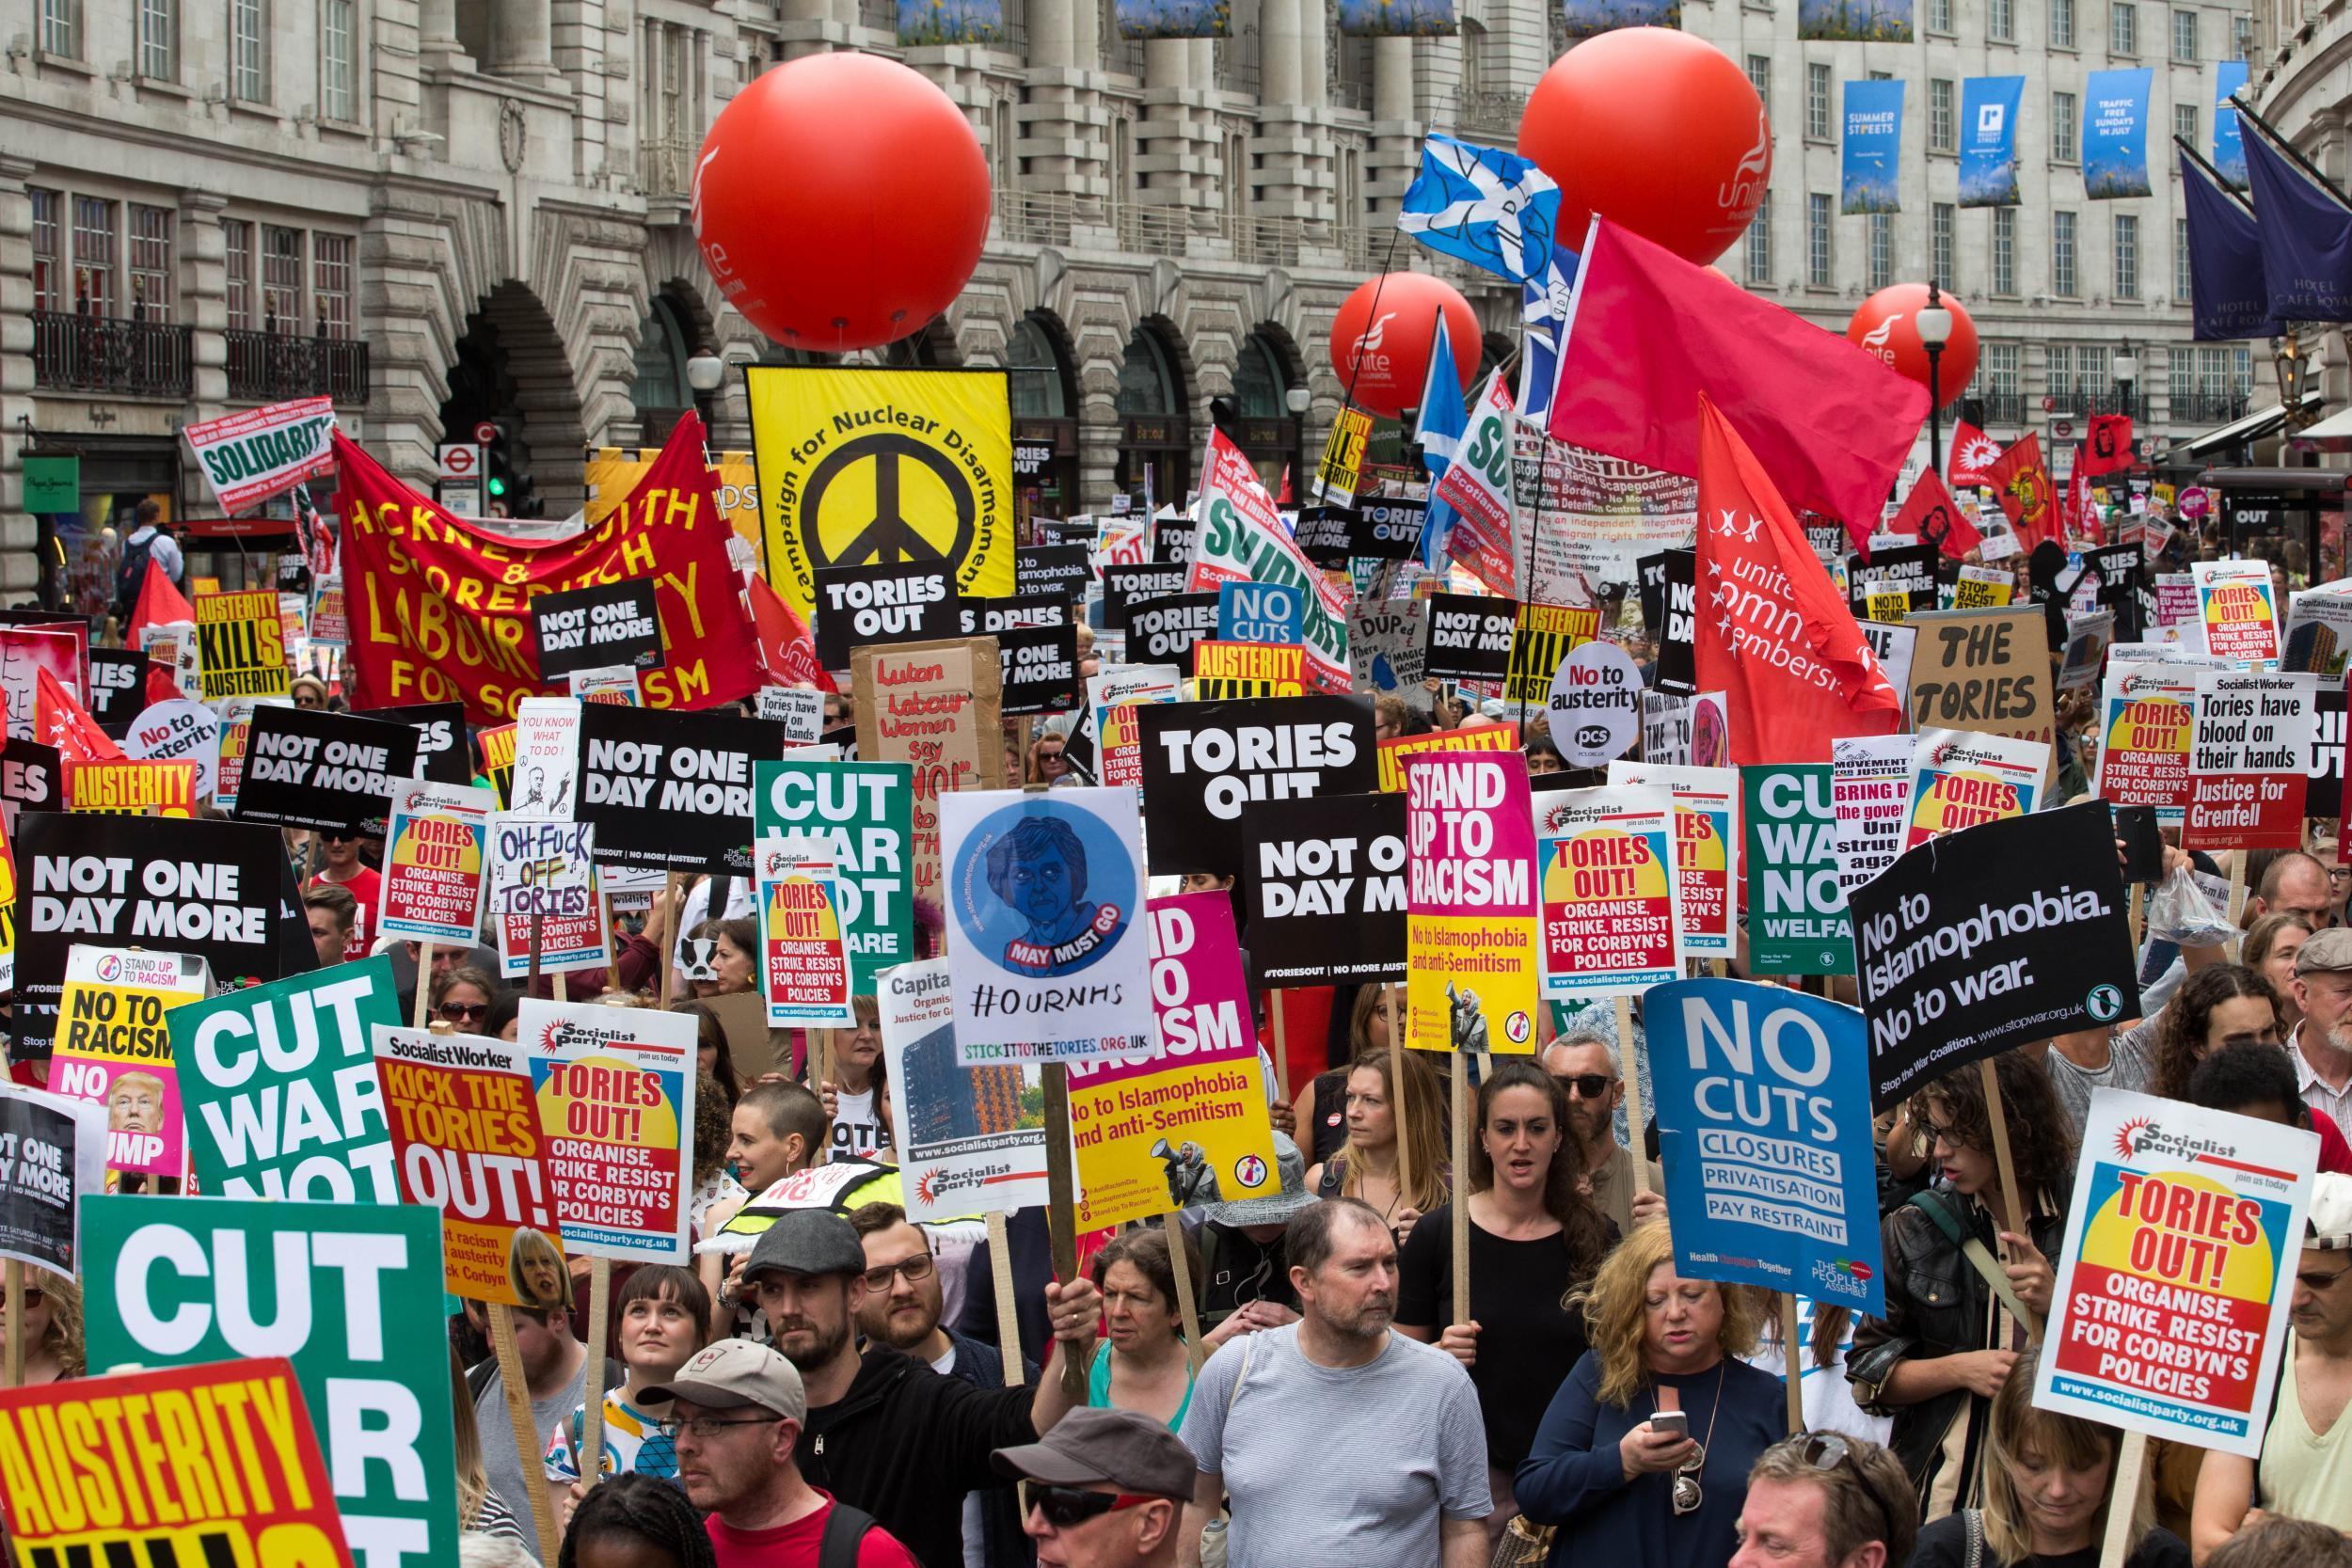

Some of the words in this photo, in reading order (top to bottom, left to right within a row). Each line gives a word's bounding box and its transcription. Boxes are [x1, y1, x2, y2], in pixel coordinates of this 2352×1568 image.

[1849, 112, 1894, 123] SUMMER
[2099, 99, 2134, 109] TRAFFIC
[2105, 109, 2126, 118] FREE
[1848, 124, 1894, 135] STREETS
[2095, 117, 2134, 128] SUNDAYS
[2100, 127, 2109, 135] IN
[2111, 126, 2131, 135] JULY
[2295, 279, 2337, 293] HOTEL
[1346, 353, 1390, 372] unite
[832, 405, 941, 436] Nuclear
[203, 417, 330, 484] SOLIDARITY
[789, 428, 828, 462] for
[1514, 462, 1538, 477] Stop
[1543, 465, 1561, 479] the
[1565, 467, 1597, 487] Racist
[1599, 476, 1678, 494] Scapegoating
[1563, 484, 1601, 499] Borders
[944, 428, 996, 594] Disarmament
[1561, 497, 1604, 514] Detention
[1606, 505, 1641, 514] Centres
[1609, 494, 1623, 504] No
[1626, 491, 1652, 503] More
[1648, 499, 1670, 514] Stop
[1672, 499, 1696, 511] Raids
[778, 468, 816, 603] Campaign
[1602, 531, 1632, 543] rights
[1637, 531, 1687, 541] movement
[826, 575, 946, 610] TORIES
[1958, 592, 1996, 606] RACIST
[1959, 579, 1989, 592] STOP
[2210, 587, 2260, 604] TORIES
[196, 591, 278, 623] AUSTERITY
[1232, 589, 1292, 624] NO
[1874, 596, 1889, 609] NO
[1891, 595, 1903, 608] TO
[2221, 605, 2254, 621] OUT!
[539, 609, 587, 632] NOT
[590, 600, 639, 627] ONE
[853, 604, 924, 637] OUT
[198, 615, 282, 672] KILLS
[542, 627, 587, 652] DAY
[590, 616, 654, 644] MORE
[1232, 621, 1290, 643] CUTS
[1938, 622, 2012, 668] THE
[1199, 645, 1303, 679] AUSTERITY
[1350, 644, 1378, 659] There
[1392, 647, 1424, 663] MAGIC
[204, 668, 285, 697] AUSTERITY
[877, 659, 944, 686] Luton
[1570, 663, 1599, 686] No
[1601, 665, 1623, 685] to
[2217, 679, 2259, 690] Socialist
[2260, 679, 2295, 689] Worker
[764, 697, 791, 711] Tories
[795, 700, 817, 713] have
[888, 689, 970, 717] Labour
[1551, 689, 1638, 712] austerity
[1915, 675, 2037, 723] TORIES
[2201, 694, 2253, 718] Tories
[2260, 694, 2300, 717] have
[522, 716, 545, 728] YOU
[547, 717, 575, 729] KNOW
[787, 726, 814, 740] hands
[791, 716, 803, 725] on
[881, 717, 957, 739] Women
[2199, 720, 2247, 743] blood
[2252, 724, 2274, 742] on
[533, 731, 561, 742] WHAT
[1159, 722, 1356, 773] TORIES
[1576, 729, 1609, 746] pcs
[530, 745, 544, 756] TO
[909, 740, 944, 765] say
[1835, 759, 1907, 768] MOVEMENT
[2197, 746, 2237, 769] their
[2244, 745, 2296, 768] hands
[1856, 767, 1908, 775] JUSTICE
[771, 770, 898, 822] CUT
[1410, 762, 1506, 810] STAND
[1835, 783, 1891, 801] BRING
[2192, 779, 2254, 802] Justice
[2261, 777, 2287, 800] for
[1557, 815, 1600, 827] Party
[1562, 806, 1623, 815] Socialist
[2191, 803, 2261, 828] Grenfell
[501, 829, 532, 861] OH
[537, 823, 590, 863] FUCK
[1411, 812, 1437, 858] UP
[1444, 810, 1493, 858] TO
[2188, 834, 2243, 846] www.swp.org.uk
[1554, 835, 1650, 868] TORIES
[34, 856, 133, 894] NOT
[142, 859, 239, 901] ONE
[520, 856, 565, 888] OFF
[1411, 859, 1529, 907] RACISM
[1574, 868, 1637, 898] OUT!
[500, 885, 588, 914] TORIES
[1565, 900, 1650, 919] ORGANISE,
[31, 895, 125, 935] DAY
[133, 901, 266, 944] MORE
[1095, 906, 1120, 933] GO
[1549, 919, 1609, 937] STRIKE,
[1612, 916, 1668, 934] RESIST
[1863, 911, 1897, 960] No
[1899, 894, 1930, 931] to
[1009, 943, 1050, 964] MAY
[1054, 929, 1101, 966] MUST
[1412, 925, 1422, 944] No
[1425, 927, 1432, 945] to
[1434, 927, 1527, 951] Islamophobia
[1552, 938, 1582, 954] FOR
[1588, 934, 1667, 952] CORBYN'S
[1866, 885, 2111, 1003] Islamophobia.
[1412, 950, 1426, 970] and
[1429, 952, 1521, 972] anti-Semitism
[1574, 952, 1647, 969] POLICIES
[1554, 973, 1671, 985] www.socialistparty.org.uk
[72, 990, 122, 1022] NO
[126, 995, 163, 1026] TO
[970, 983, 1123, 1018] #OURNHS
[1873, 1007, 1912, 1056] No
[1913, 988, 1947, 1026] to
[1950, 957, 2034, 1007] war.
[194, 975, 373, 1088] CUT
[1978, 1004, 2085, 1046] www.stopwar.org.uk
[389, 1036, 453, 1066] Socialist
[453, 1046, 512, 1069] Worker
[964, 1036, 1149, 1061] STICKITTOTHETORIES.ORG.UK
[1681, 997, 1831, 1087] NO
[1881, 1075, 1901, 1094] Stop
[1901, 1066, 1914, 1081] the
[1914, 1055, 1930, 1072] War
[1930, 1036, 1977, 1062] Coalition.
[386, 1063, 457, 1107] KICK
[462, 1074, 529, 1114] THE
[1693, 1077, 1838, 1143] CUTS
[390, 1098, 536, 1158] TORIES
[2143, 1122, 2236, 1158] Socialist
[1703, 1132, 1836, 1178] CLOSURES
[2133, 1136, 2199, 1163] Party
[405, 1143, 550, 1227] OUT!
[1705, 1167, 1841, 1208] PRIVATISATION
[1708, 1200, 1744, 1217] PAY
[1751, 1204, 1844, 1240] RESTRAINT
[2117, 1171, 2264, 1246] TORIES
[456, 1230, 500, 1250] racism
[451, 1246, 506, 1269] austerity
[1690, 1252, 1718, 1264] Health
[1757, 1259, 1791, 1276] Together
[2130, 1226, 2230, 1290] OUT!
[463, 1266, 506, 1287] Corbyn
[114, 1223, 408, 1361] CUT
[2106, 1273, 2234, 1325] ORGANISE,
[2073, 1292, 2162, 1338] STRIKE,
[2169, 1314, 2261, 1355] RESIST
[2071, 1319, 2119, 1351] FOR
[2124, 1335, 2249, 1381] CORBYN'S
[2098, 1353, 2210, 1401] POLICIES
[2059, 1380, 2240, 1433] www.socialistparty.org.uk
[0, 1376, 314, 1536] AUSTERITY
